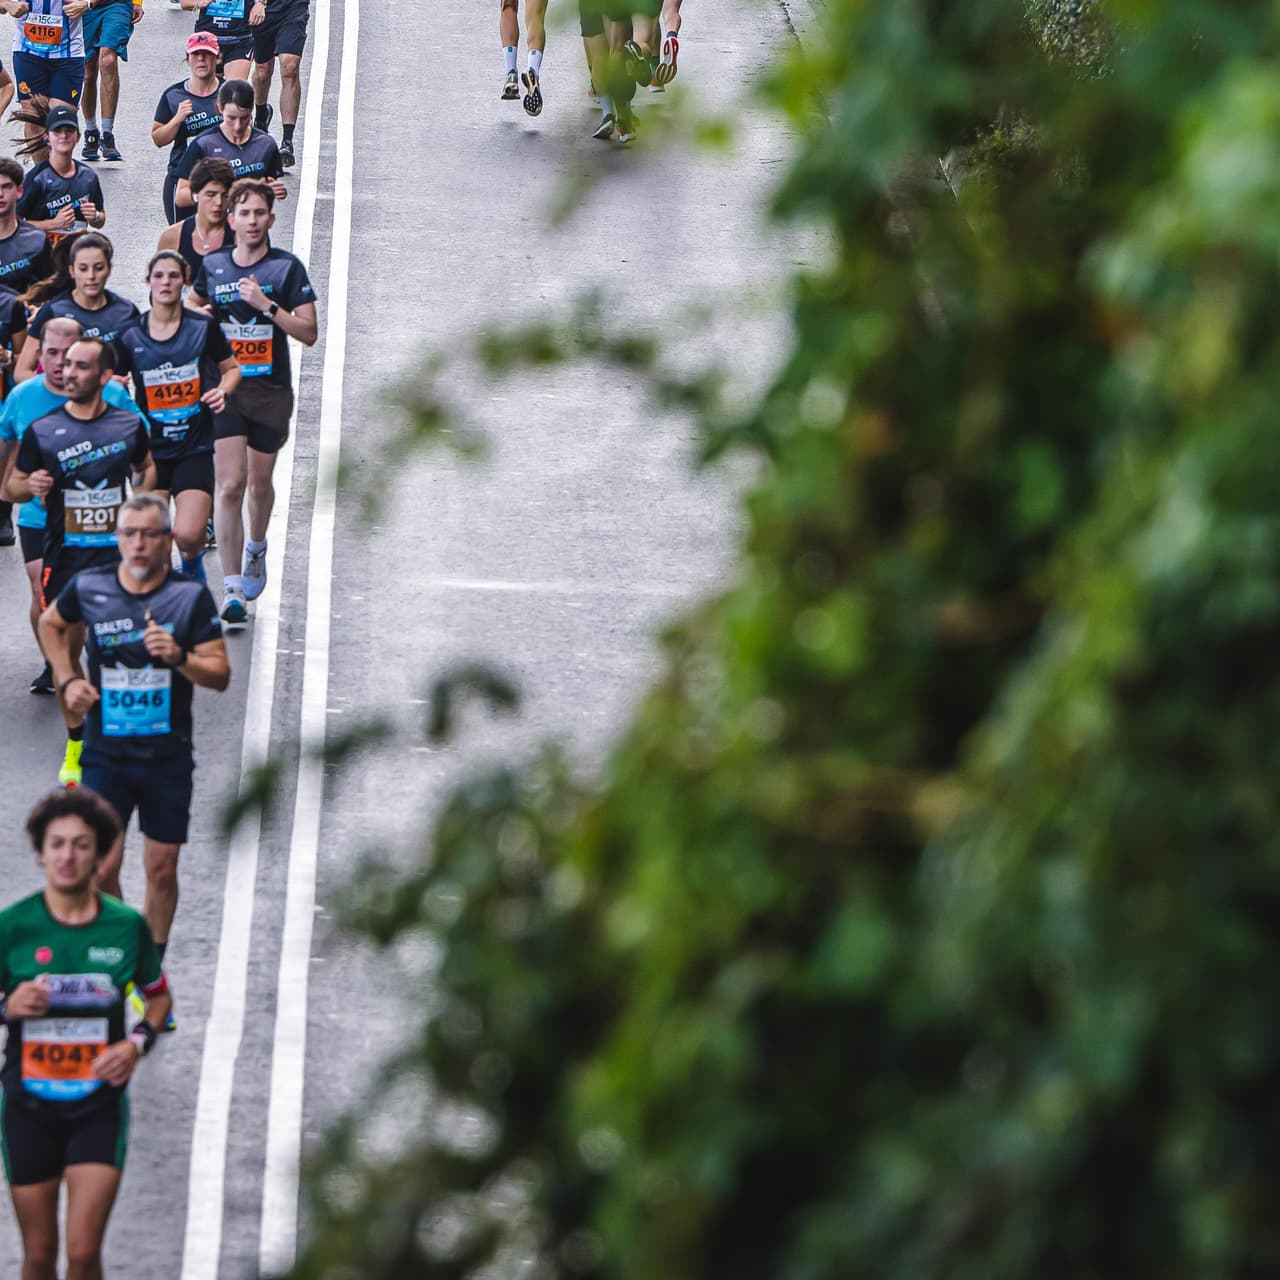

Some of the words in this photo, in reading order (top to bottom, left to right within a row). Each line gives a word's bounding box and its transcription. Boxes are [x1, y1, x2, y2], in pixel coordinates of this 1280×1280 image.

[29, 26, 56, 38] 4116
[185, 112, 208, 124] SALTO
[46, 194, 72, 210] SALTO
[234, 341, 268, 355] 206
[154, 382, 194, 400] 4142
[57, 440, 93, 462] SALTO
[59, 440, 127, 474] FOUNDATION
[74, 507, 115, 525] 1201
[107, 689, 164, 708] 5046
